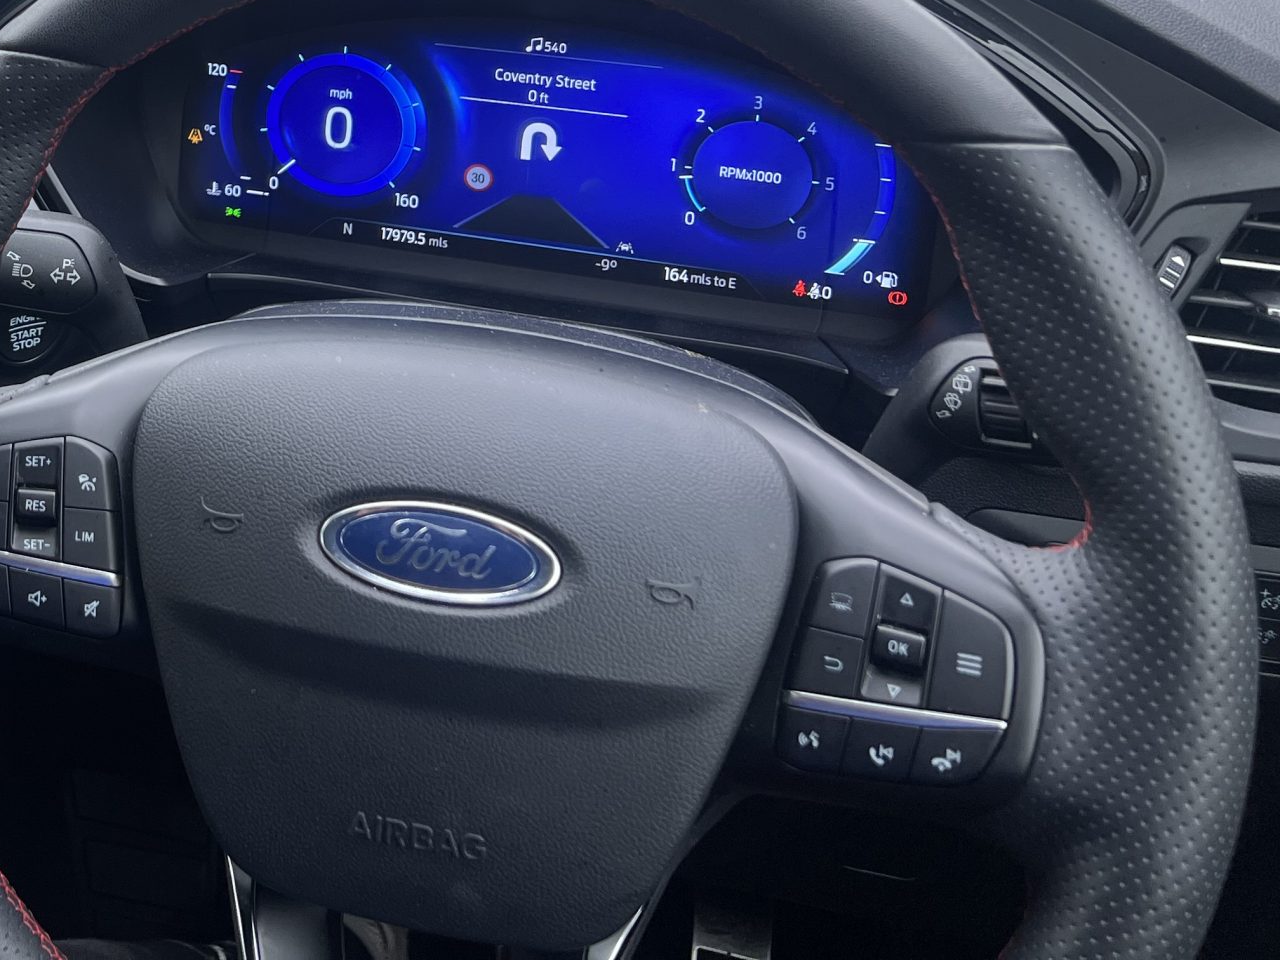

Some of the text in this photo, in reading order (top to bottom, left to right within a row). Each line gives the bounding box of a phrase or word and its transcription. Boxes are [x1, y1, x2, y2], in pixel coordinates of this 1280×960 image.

[544, 41, 567, 54] 540
[207, 63, 228, 77] 120
[495, 68, 597, 91] Coventry Street
[329, 88, 353, 101] mph
[528, 89, 549, 103] 0 ft
[754, 96, 763, 109] 3
[695, 109, 705, 123] 2
[324, 105, 353, 149] 0
[807, 121, 817, 136] 4
[670, 158, 676, 172] 1
[470, 172, 486, 184] 30
[719, 165, 782, 185] RPMx1000
[224, 183, 241, 197] 60
[269, 176, 279, 190] 0
[824, 177, 835, 191] 5
[394, 192, 419, 209] 160
[684, 211, 695, 225] 0
[342, 222, 353, 235] N
[796, 226, 807, 240] 6
[380, 226, 448, 248] 17979.5 mls
[664, 266, 737, 289] 164 mls to E
[863, 270, 873, 284] 0
[821, 286, 832, 300] 0
[10, 314, 43, 326] ENG
[10, 326, 44, 342] START
[12, 337, 41, 352] STOP
[25, 455, 52, 467] SET+
[25, 499, 46, 512] RES
[75, 530, 95, 543] LIM
[375, 516, 496, 580] Ford
[887, 640, 910, 657] OK
[351, 810, 487, 860] AIRBAG
